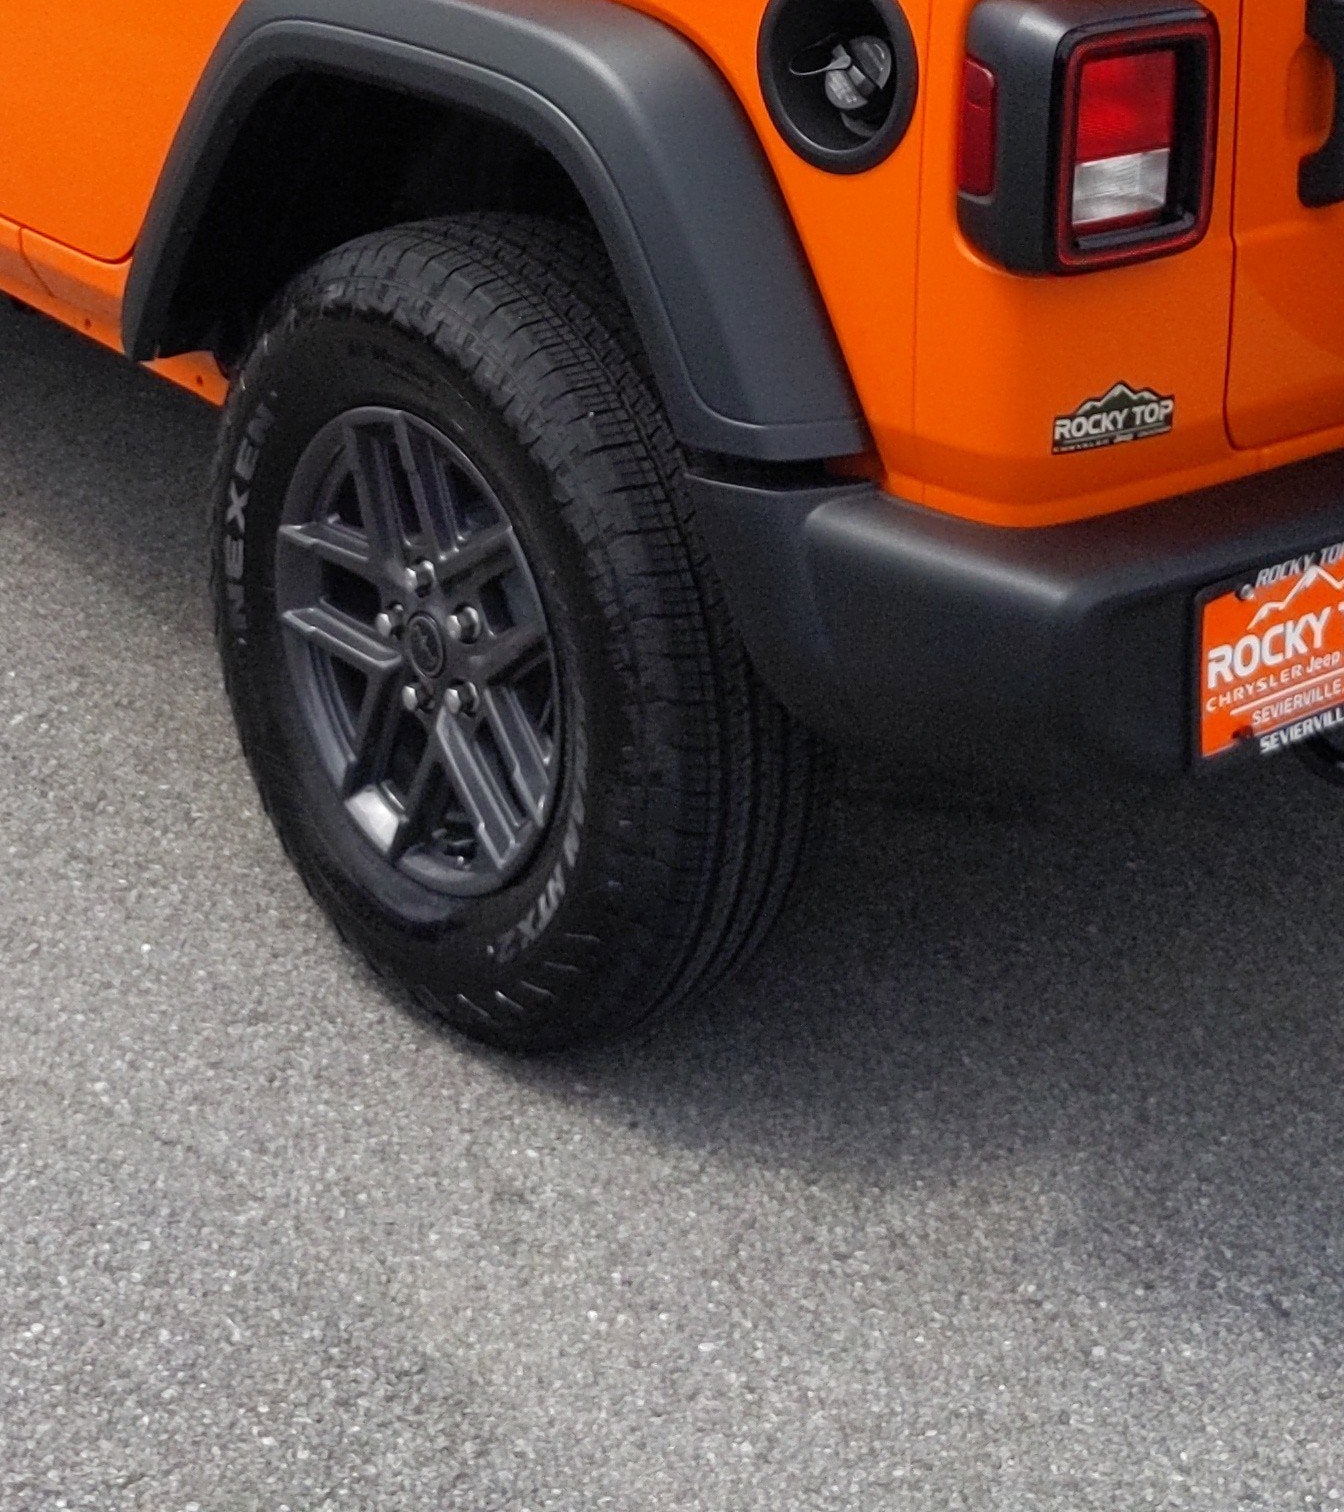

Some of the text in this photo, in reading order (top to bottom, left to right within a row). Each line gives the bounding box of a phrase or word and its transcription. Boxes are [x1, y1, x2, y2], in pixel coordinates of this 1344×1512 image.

[1054, 408, 1128, 440] ROCKY
[1132, 399, 1174, 426] TOP
[1256, 552, 1316, 587] ROCKY
[1207, 606, 1331, 688] ROCKY
[1206, 664, 1304, 712] CHRYSLER
[1306, 651, 1341, 674] Jeep
